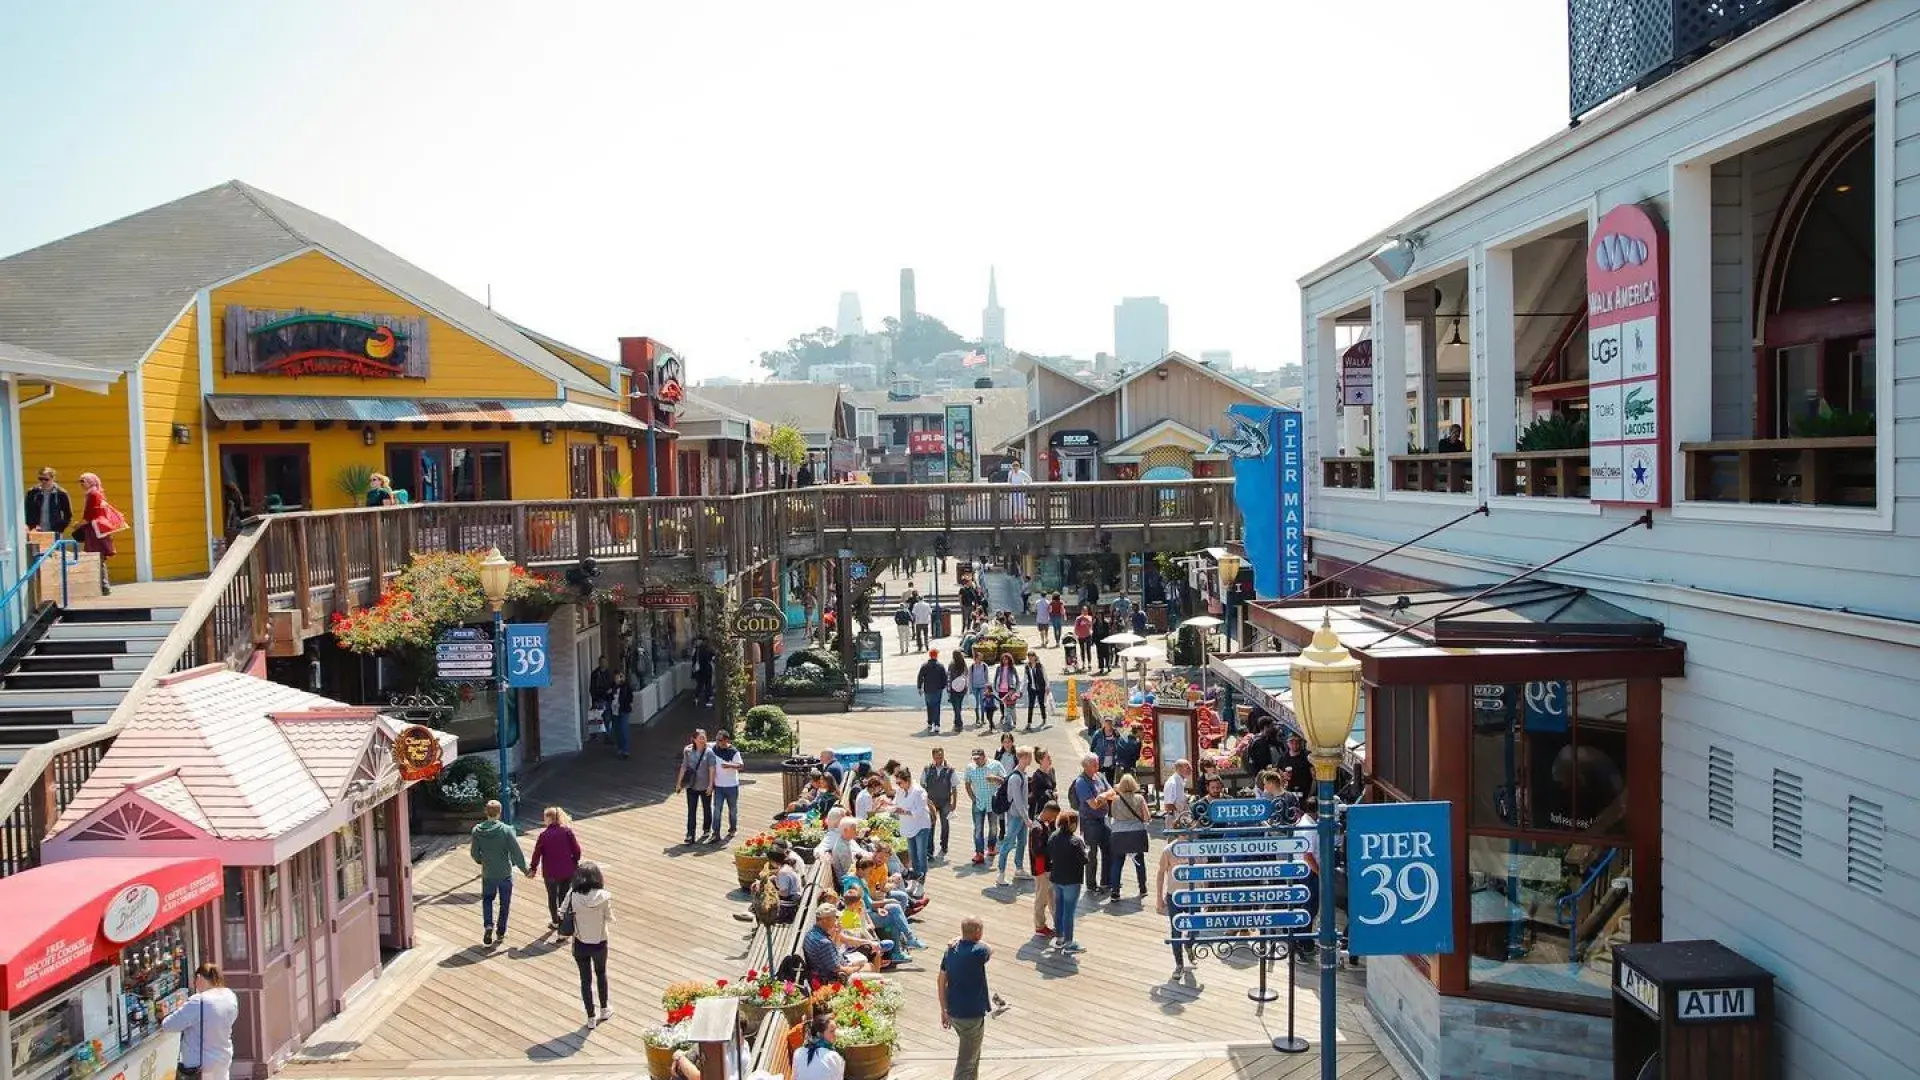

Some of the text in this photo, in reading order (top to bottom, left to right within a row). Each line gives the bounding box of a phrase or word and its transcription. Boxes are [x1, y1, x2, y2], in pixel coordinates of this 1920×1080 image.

[1588, 279, 1656, 316] WALK AMERICA
[1592, 338, 1618, 364] UGG
[1625, 422, 1655, 435] LACOSTE
[1284, 419, 1298, 591] PIER MARKET
[736, 617, 780, 632] GOLD
[512, 636, 543, 648] PIER
[512, 648, 545, 676] 39
[1216, 803, 1265, 818] PIER 39
[1199, 842, 1278, 854] SWISS LOUIS
[1360, 831, 1436, 860] PIER
[1203, 865, 1281, 878] RESTROOMS
[1197, 890, 1292, 903] LEVEL 2 SHOPS
[1358, 861, 1440, 925] 39
[1206, 915, 1273, 928] BAY VIEWS
[1626, 969, 1655, 1006] ATM
[1684, 990, 1745, 1015] ATM
